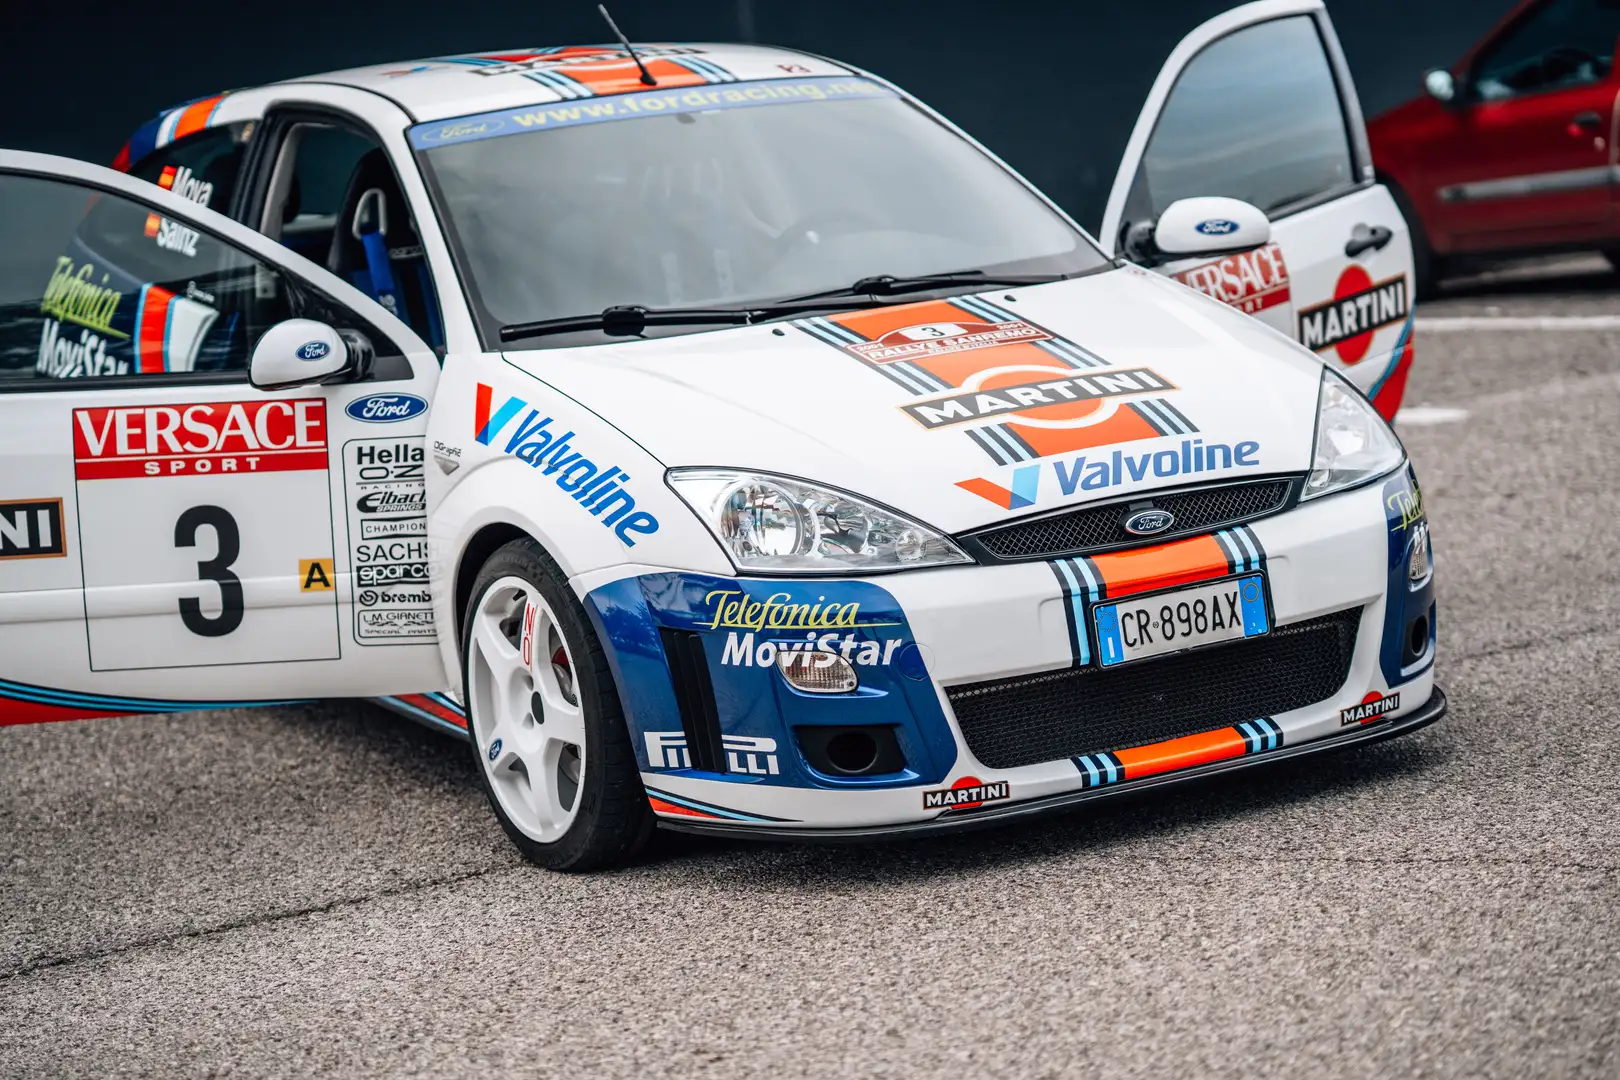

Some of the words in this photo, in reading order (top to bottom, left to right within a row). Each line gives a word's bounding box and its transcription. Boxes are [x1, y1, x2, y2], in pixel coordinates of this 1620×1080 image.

[1174, 246, 1288, 302] ERSACE
[921, 326, 946, 336] 3
[1302, 284, 1405, 350] MARTINI
[869, 339, 937, 360] RALLYE
[939, 327, 1037, 349] SANREMO
[363, 397, 411, 418] Ford
[913, 371, 1165, 425] MARTINI
[76, 400, 325, 457] VERSACE
[144, 457, 261, 475] SPORT
[357, 443, 425, 465] Hella
[1052, 439, 1261, 496] Valvoline
[360, 483, 425, 491] RACING
[504, 408, 660, 549] Valvoline
[376, 503, 423, 513] SPRINGS
[365, 522, 427, 534] CHAMPION
[174, 504, 244, 637] 3
[303, 562, 332, 590] A
[1121, 609, 1154, 648] CR
[1159, 591, 1242, 641] 898AX
[721, 631, 902, 668] MoviStar
[1343, 695, 1399, 724] MARTINI
[926, 783, 1007, 808] MARTINI
